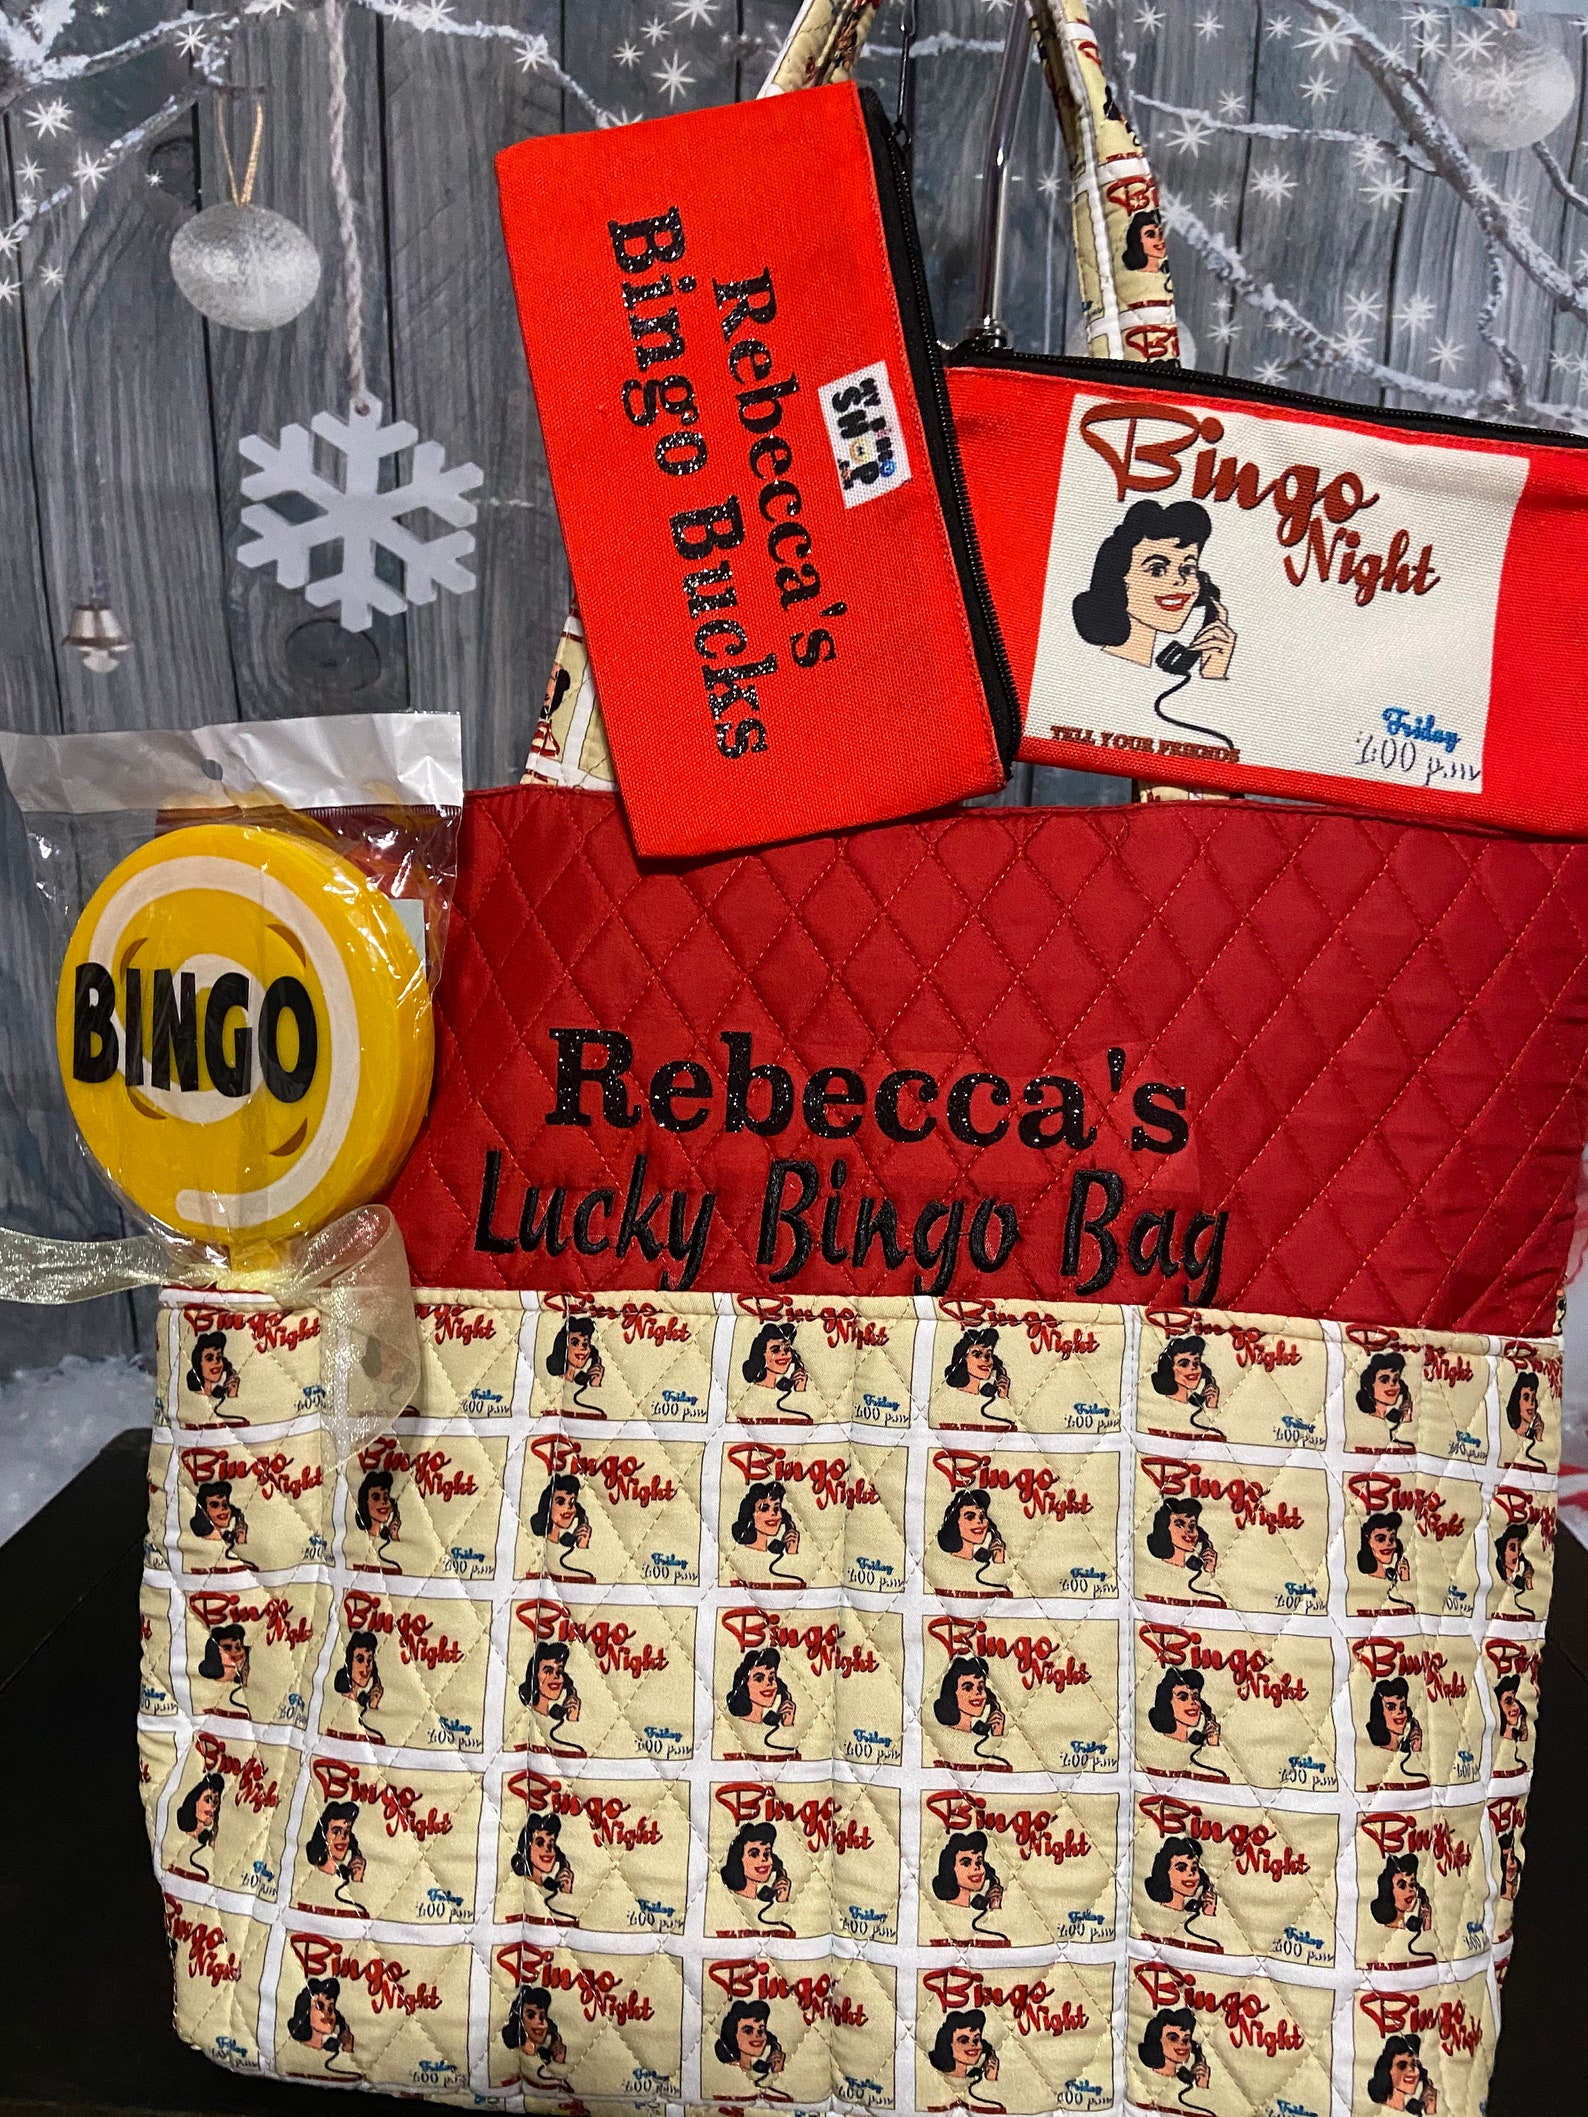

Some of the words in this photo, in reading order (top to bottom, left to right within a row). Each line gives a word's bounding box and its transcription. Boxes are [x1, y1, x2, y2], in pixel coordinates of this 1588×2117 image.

[609, 207, 708, 476] Bingo
[671, 495, 776, 760] Bucks
[712, 268, 836, 666] Rebecca's
[1081, 402, 1379, 545] Bingo
[1284, 518, 1441, 606] Night
[1050, 726, 1095, 745] TELL
[1100, 731, 1153, 753] YOUR
[1158, 739, 1240, 763] FRIENDS
[1382, 706, 1461, 753] Friday
[73, 961, 317, 1103] BINGO
[546, 1028, 1190, 1154] Rebecca's
[474, 1151, 715, 1291] Lucky
[756, 1159, 1018, 1295] Bingo
[1060, 1169, 1228, 1306] Bag
[543, 1291, 664, 1323] Bingo
[736, 1293, 861, 1331] Bingo
[939, 1299, 1064, 1341] Bingo
[1145, 1305, 1267, 1346] Bingo
[435, 1314, 497, 1346] Night
[624, 1317, 691, 1347] Night
[828, 1317, 890, 1349] Night
[1030, 1327, 1100, 1361] Night
[1236, 1339, 1302, 1373] Night
[181, 1447, 295, 1486] Bingo
[357, 1436, 452, 1475] Bingo
[530, 1434, 645, 1489] Bingo
[727, 1443, 850, 1494] Bingo
[932, 1450, 1061, 1502] Bingo
[420, 1470, 478, 1502] Night
[608, 1475, 678, 1507] Night
[816, 1478, 881, 1512] Night
[1023, 1489, 1094, 1522] Night
[1140, 1456, 1272, 1513] Bingo
[1348, 1472, 1446, 1516] Bingo
[1235, 1499, 1303, 1535] Night
[189, 1591, 294, 1629] Bingo
[344, 1591, 433, 1639] Bingo
[516, 1600, 636, 1657] Bingo
[401, 1635, 465, 1670] Night
[721, 1606, 845, 1658] Bingo
[928, 1616, 1061, 1671] Bingo
[1139, 1623, 1272, 1681] Bingo
[600, 1644, 669, 1678] Night
[811, 1646, 880, 1678] Night
[1022, 1657, 1092, 1693] Night
[1352, 1637, 1448, 1680] Bingo
[1239, 1671, 1309, 1708] Night
[313, 1757, 424, 1819] Bingo
[507, 1771, 631, 1829] Bingo
[716, 1782, 841, 1834] Bingo
[386, 1807, 453, 1842] Night
[593, 1817, 663, 1851] Night
[808, 1820, 874, 1854] Night
[926, 1790, 1056, 1843] Bingo
[1140, 1795, 1276, 1848] Bingo
[1362, 1812, 1455, 1860] Bingo
[1020, 1830, 1091, 1864] Night
[1236, 1844, 1310, 1882] Night
[291, 1933, 410, 1996] Bingo
[496, 1941, 623, 2004] Bingo
[709, 1959, 839, 2009] Bingo
[371, 1982, 442, 2015] Night
[583, 1990, 655, 2025] Night
[803, 1997, 868, 2027] Night
[923, 1966, 1054, 2021] Bingo
[1133, 1961, 1269, 2027] Bingo
[1018, 2001, 1089, 2036] Night
[1360, 1991, 1464, 2040] Bingo
[1230, 2016, 1304, 2058] Night
